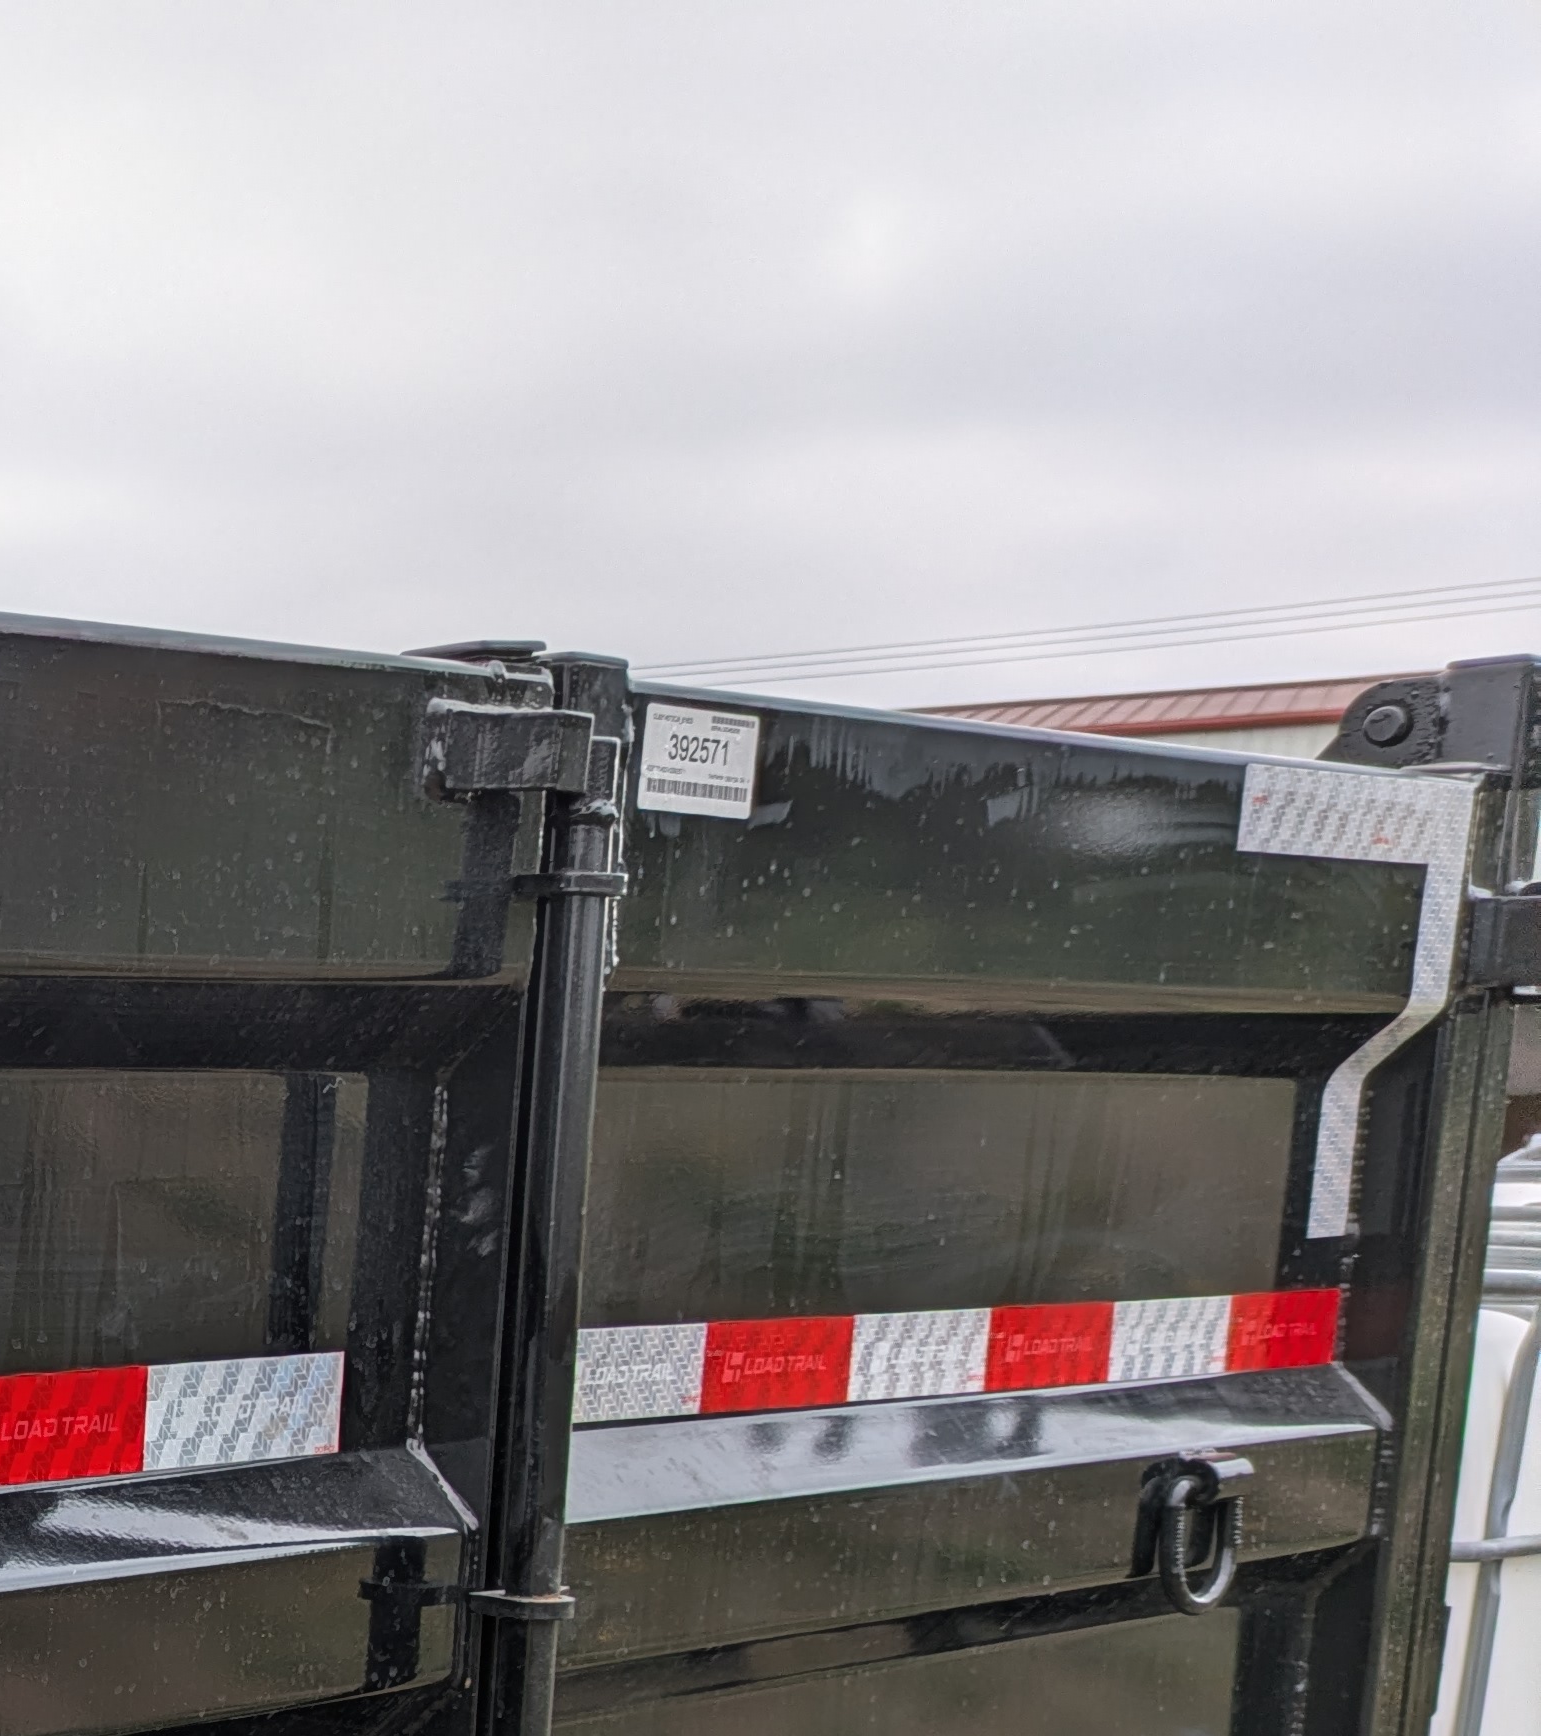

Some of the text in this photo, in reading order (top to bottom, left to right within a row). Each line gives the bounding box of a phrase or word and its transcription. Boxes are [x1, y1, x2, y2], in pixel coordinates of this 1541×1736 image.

[668, 733, 730, 766] 392571
[744, 1353, 827, 1375] LOAD TRAIL
[1, 1412, 119, 1442] LOAD TRAIL
